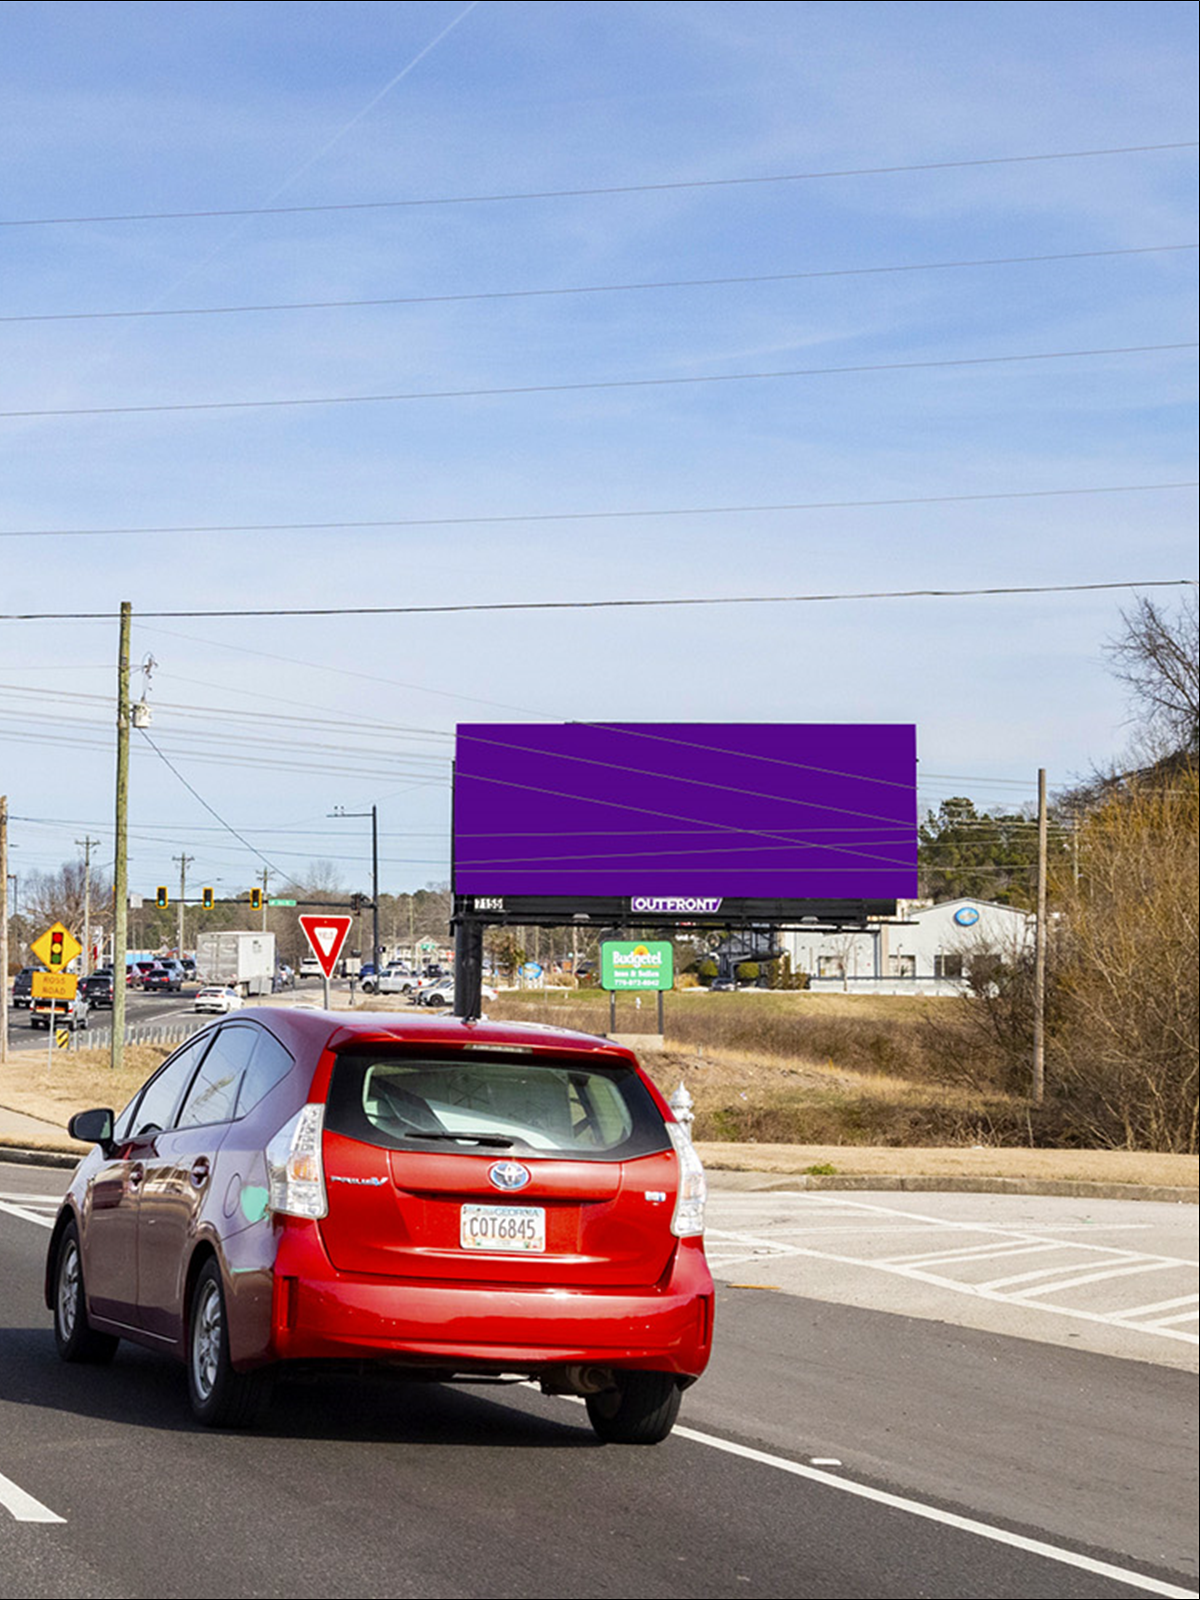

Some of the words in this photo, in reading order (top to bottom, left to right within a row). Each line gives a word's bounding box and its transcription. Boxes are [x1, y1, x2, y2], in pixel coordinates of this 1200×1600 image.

[634, 898, 717, 910] OUTFRONT
[613, 951, 662, 968] Budgetel
[43, 976, 66, 985] ROSS
[42, 987, 66, 995] ROAD
